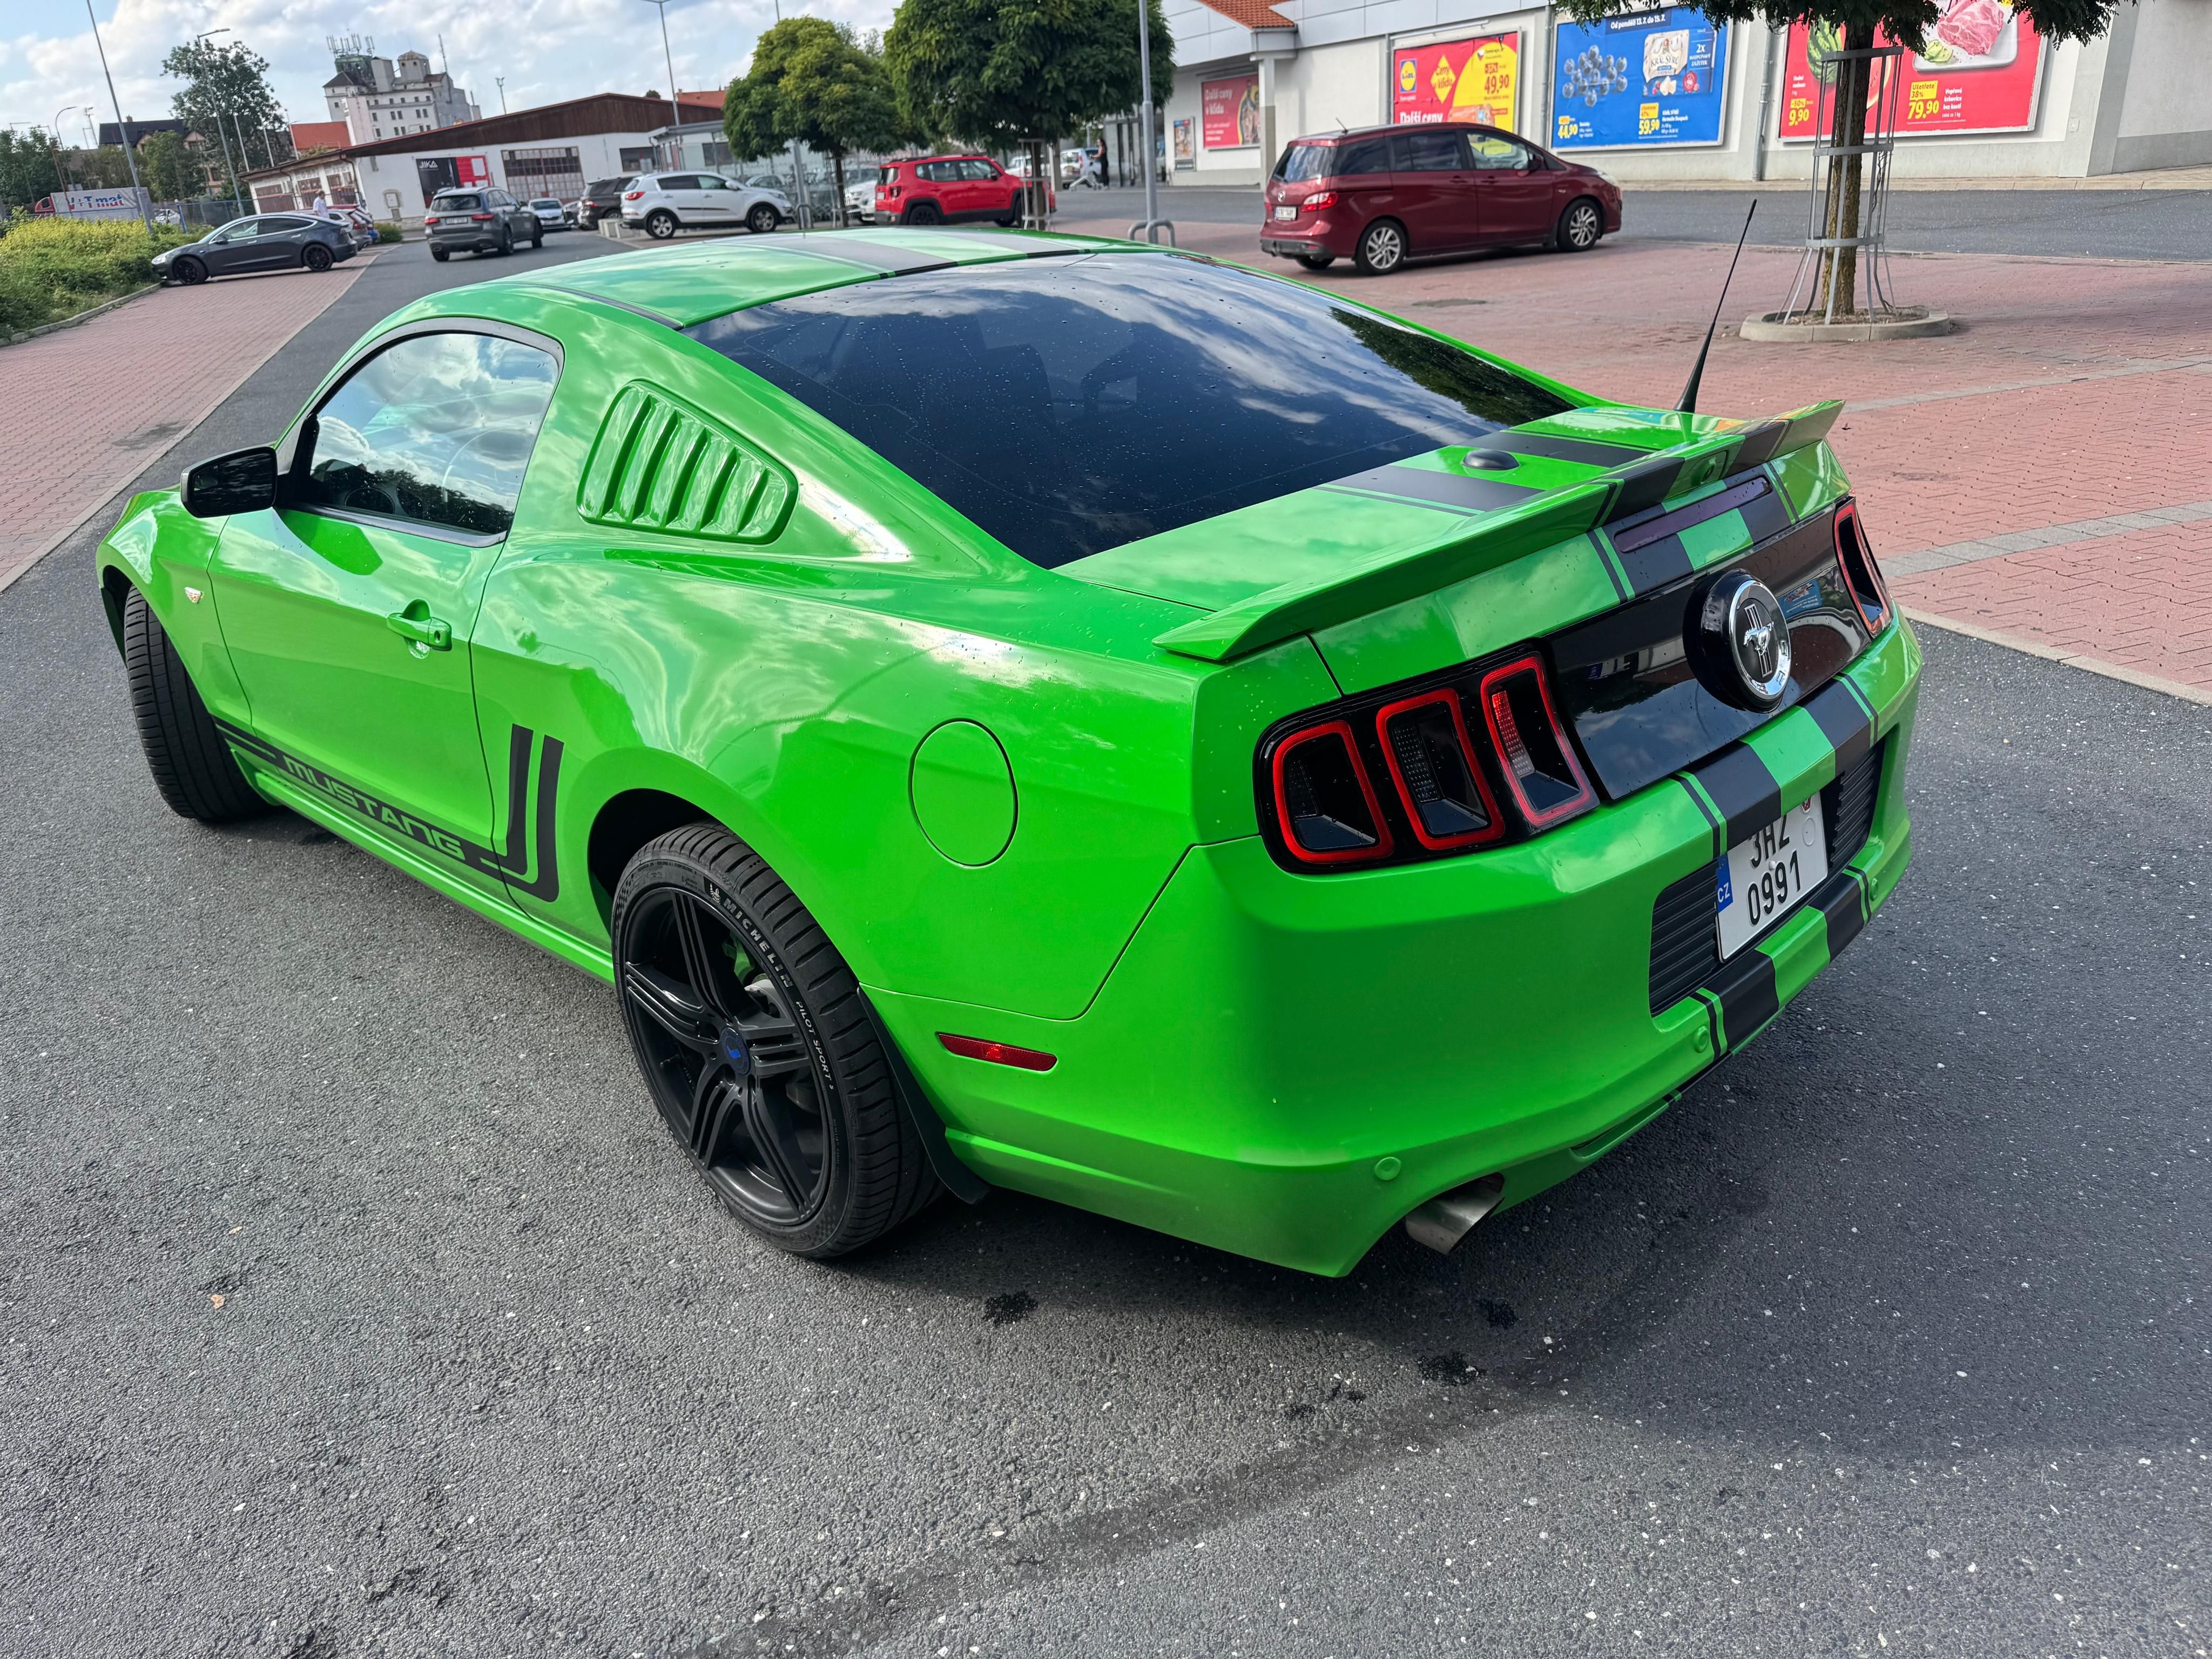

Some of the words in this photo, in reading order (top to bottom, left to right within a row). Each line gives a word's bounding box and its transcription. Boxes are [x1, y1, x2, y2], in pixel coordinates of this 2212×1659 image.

[282, 755, 466, 860] MUSTANG
[1717, 882, 1730, 903] CZ
[1748, 850, 1800, 925] 0991
[724, 898, 793, 987] MICHELIN
[796, 1001, 816, 1035] PILOT
[813, 1039, 832, 1081] SPORT
